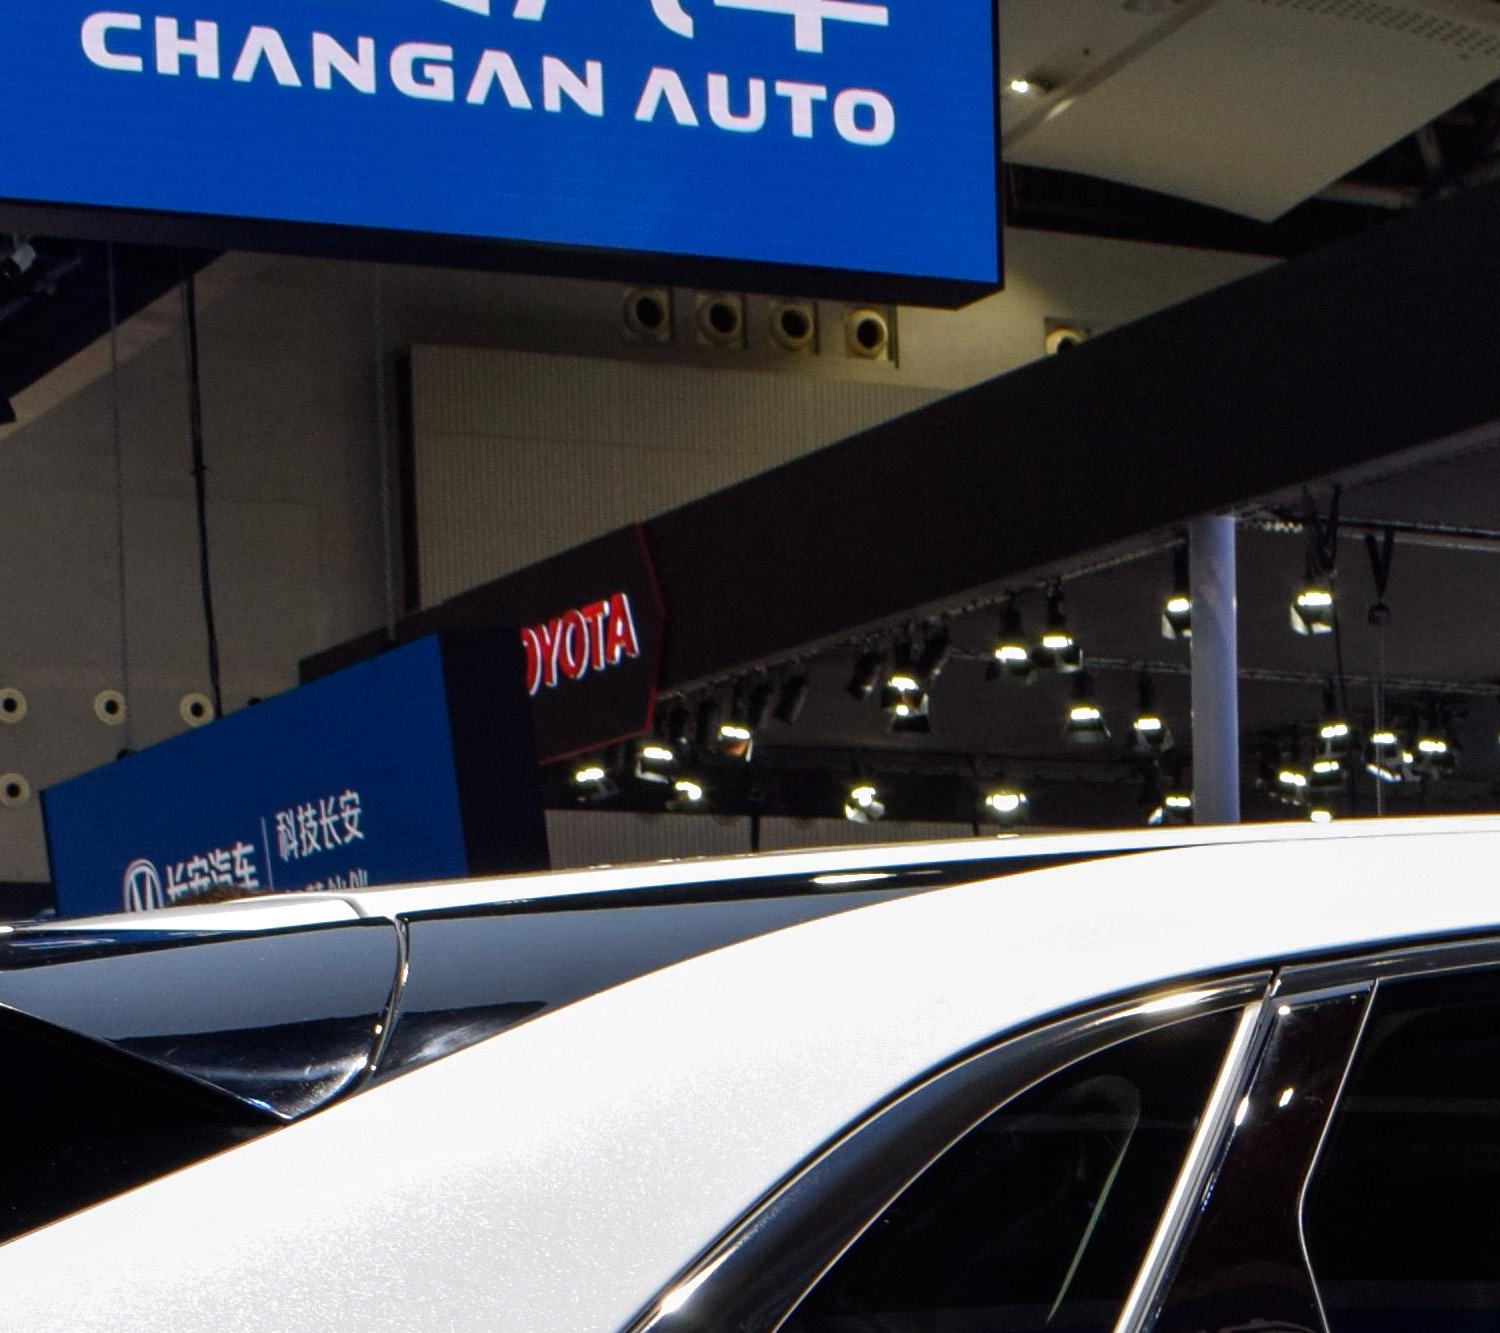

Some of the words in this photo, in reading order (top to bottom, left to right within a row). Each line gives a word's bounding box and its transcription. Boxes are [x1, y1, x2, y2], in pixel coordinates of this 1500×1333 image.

[80, 10, 606, 120] CHANGAN
[634, 65, 898, 149] AUTO
[275, 789, 364, 863] 科技长安
